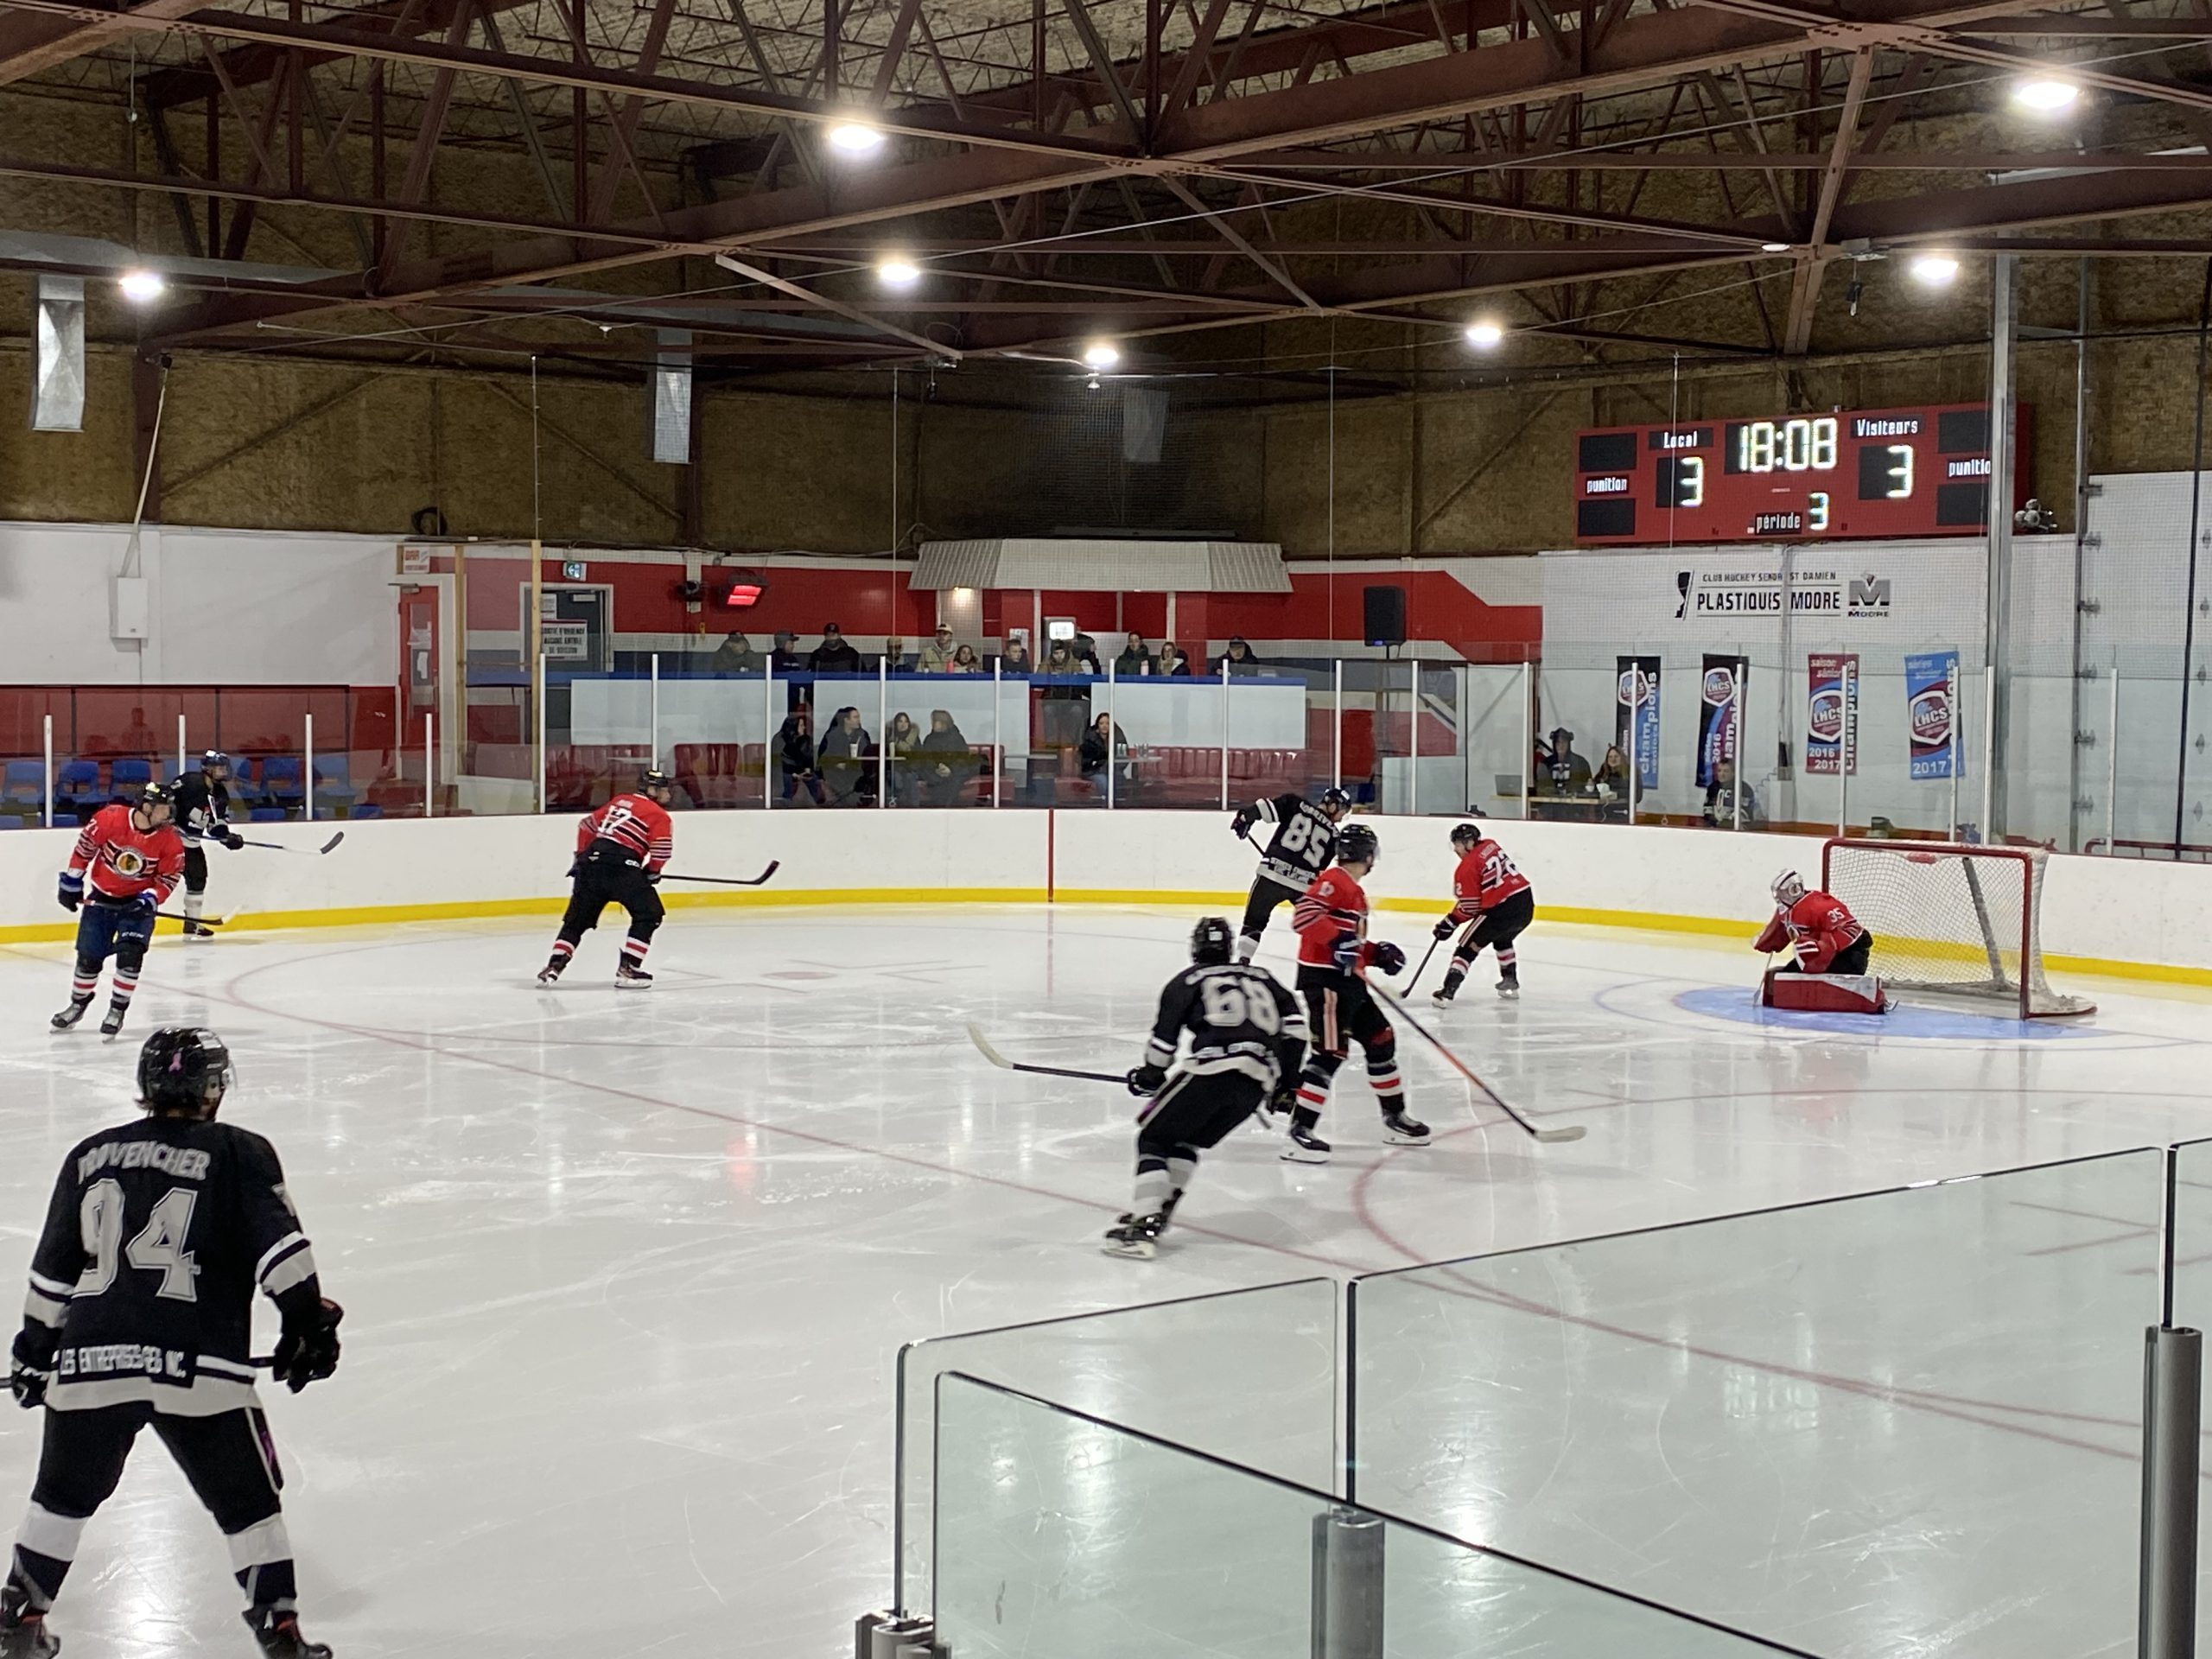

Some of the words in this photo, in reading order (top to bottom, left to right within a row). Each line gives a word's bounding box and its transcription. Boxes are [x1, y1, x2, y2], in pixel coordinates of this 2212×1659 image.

[1857, 418, 1918, 436] Visiteurs
[1663, 431, 1697, 448] Local
[1739, 418, 1837, 473] 18:08
[1887, 445, 1913, 498] 3
[1948, 458, 1992, 477] punitio
[1586, 477, 1627, 493] punition
[1681, 456, 1704, 507] 3
[1809, 493, 1828, 531] 3
[1757, 512, 1801, 534] période
[1724, 573, 1756, 582] HOCKEY
[1802, 571, 1836, 581] DAMIEN
[1790, 591, 1840, 610] MOORE
[1707, 681, 1730, 692] LHCS
[1915, 707, 1948, 727] LHCS
[1808, 747, 1835, 758] 2016
[1912, 761, 1947, 774] 2017
[1281, 813, 1331, 868] 85
[1827, 907, 1845, 923] 35
[1200, 976, 1281, 1036] 68
[71, 1178, 201, 1302] 94
